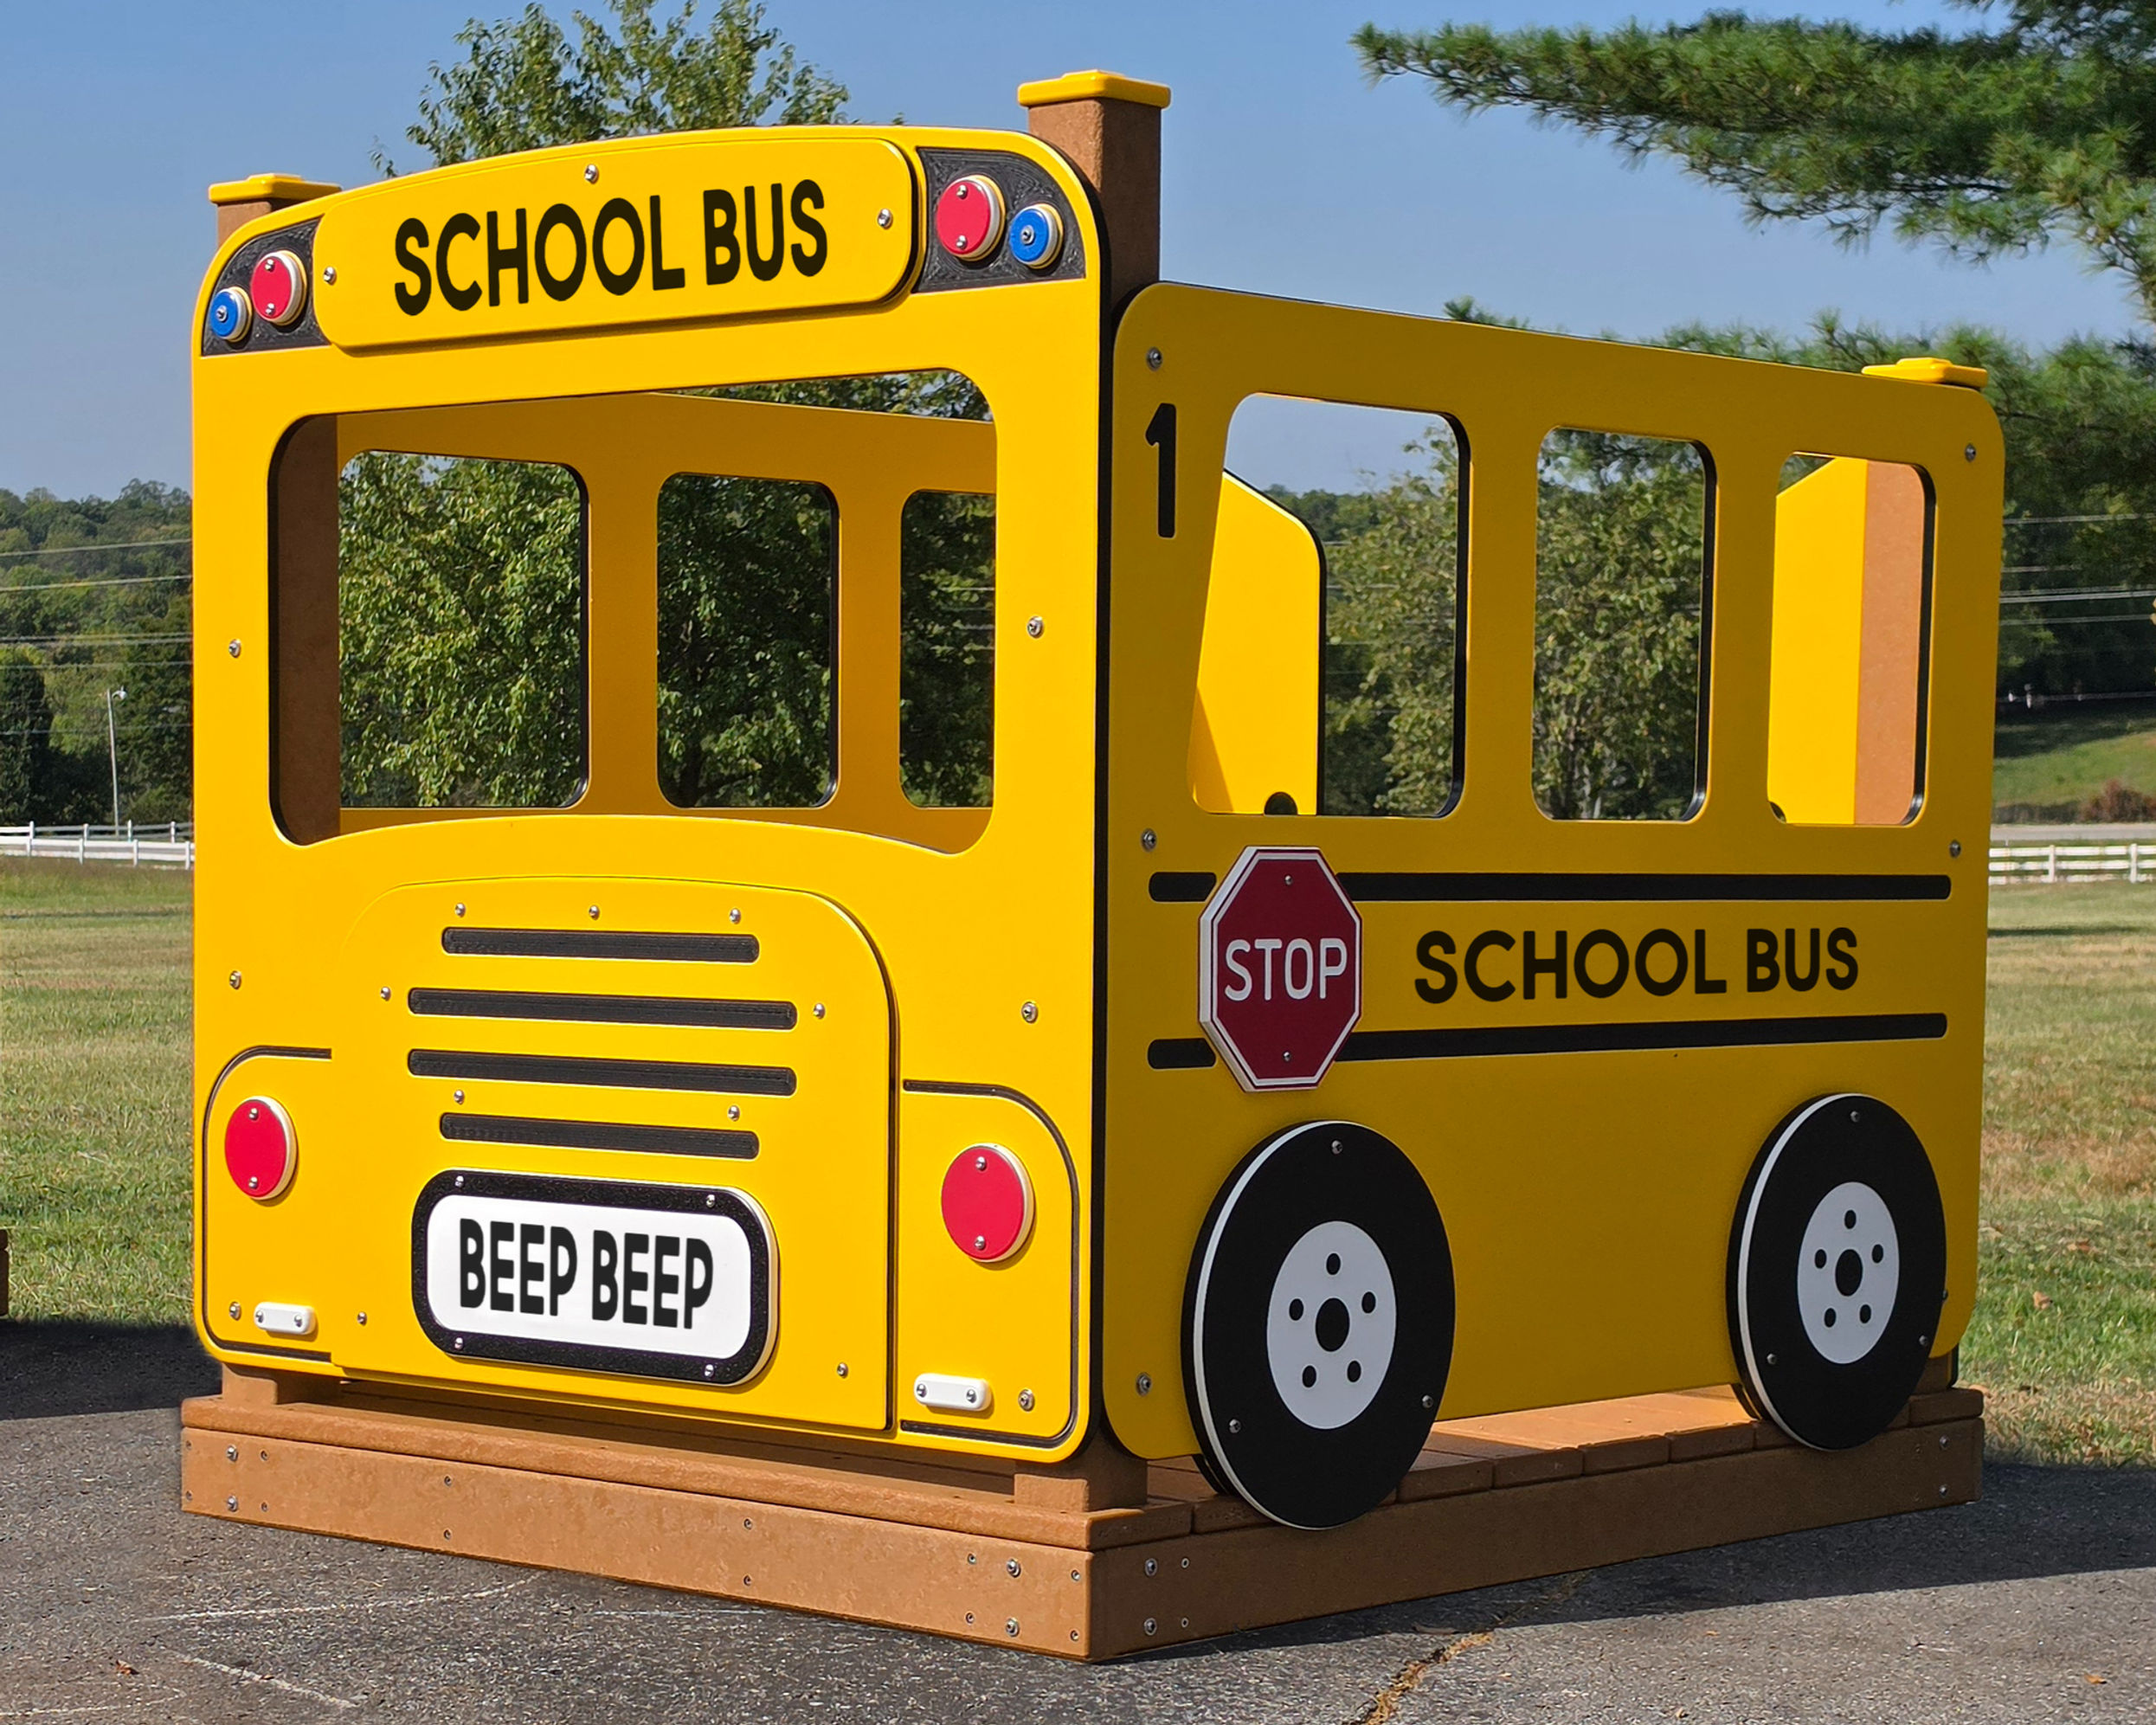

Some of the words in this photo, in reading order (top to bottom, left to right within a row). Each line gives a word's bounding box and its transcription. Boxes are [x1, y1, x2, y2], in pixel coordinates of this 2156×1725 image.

[395, 195, 685, 316] SCHOOL
[703, 179, 827, 286] BUS
[1144, 402, 1178, 538] 1
[1224, 937, 1348, 1002] STOP
[1414, 928, 1728, 1005] SCHOOL
[1746, 927, 1859, 993] BUS
[460, 1217, 577, 1316] BEEP
[591, 1229, 714, 1329] BEEP
